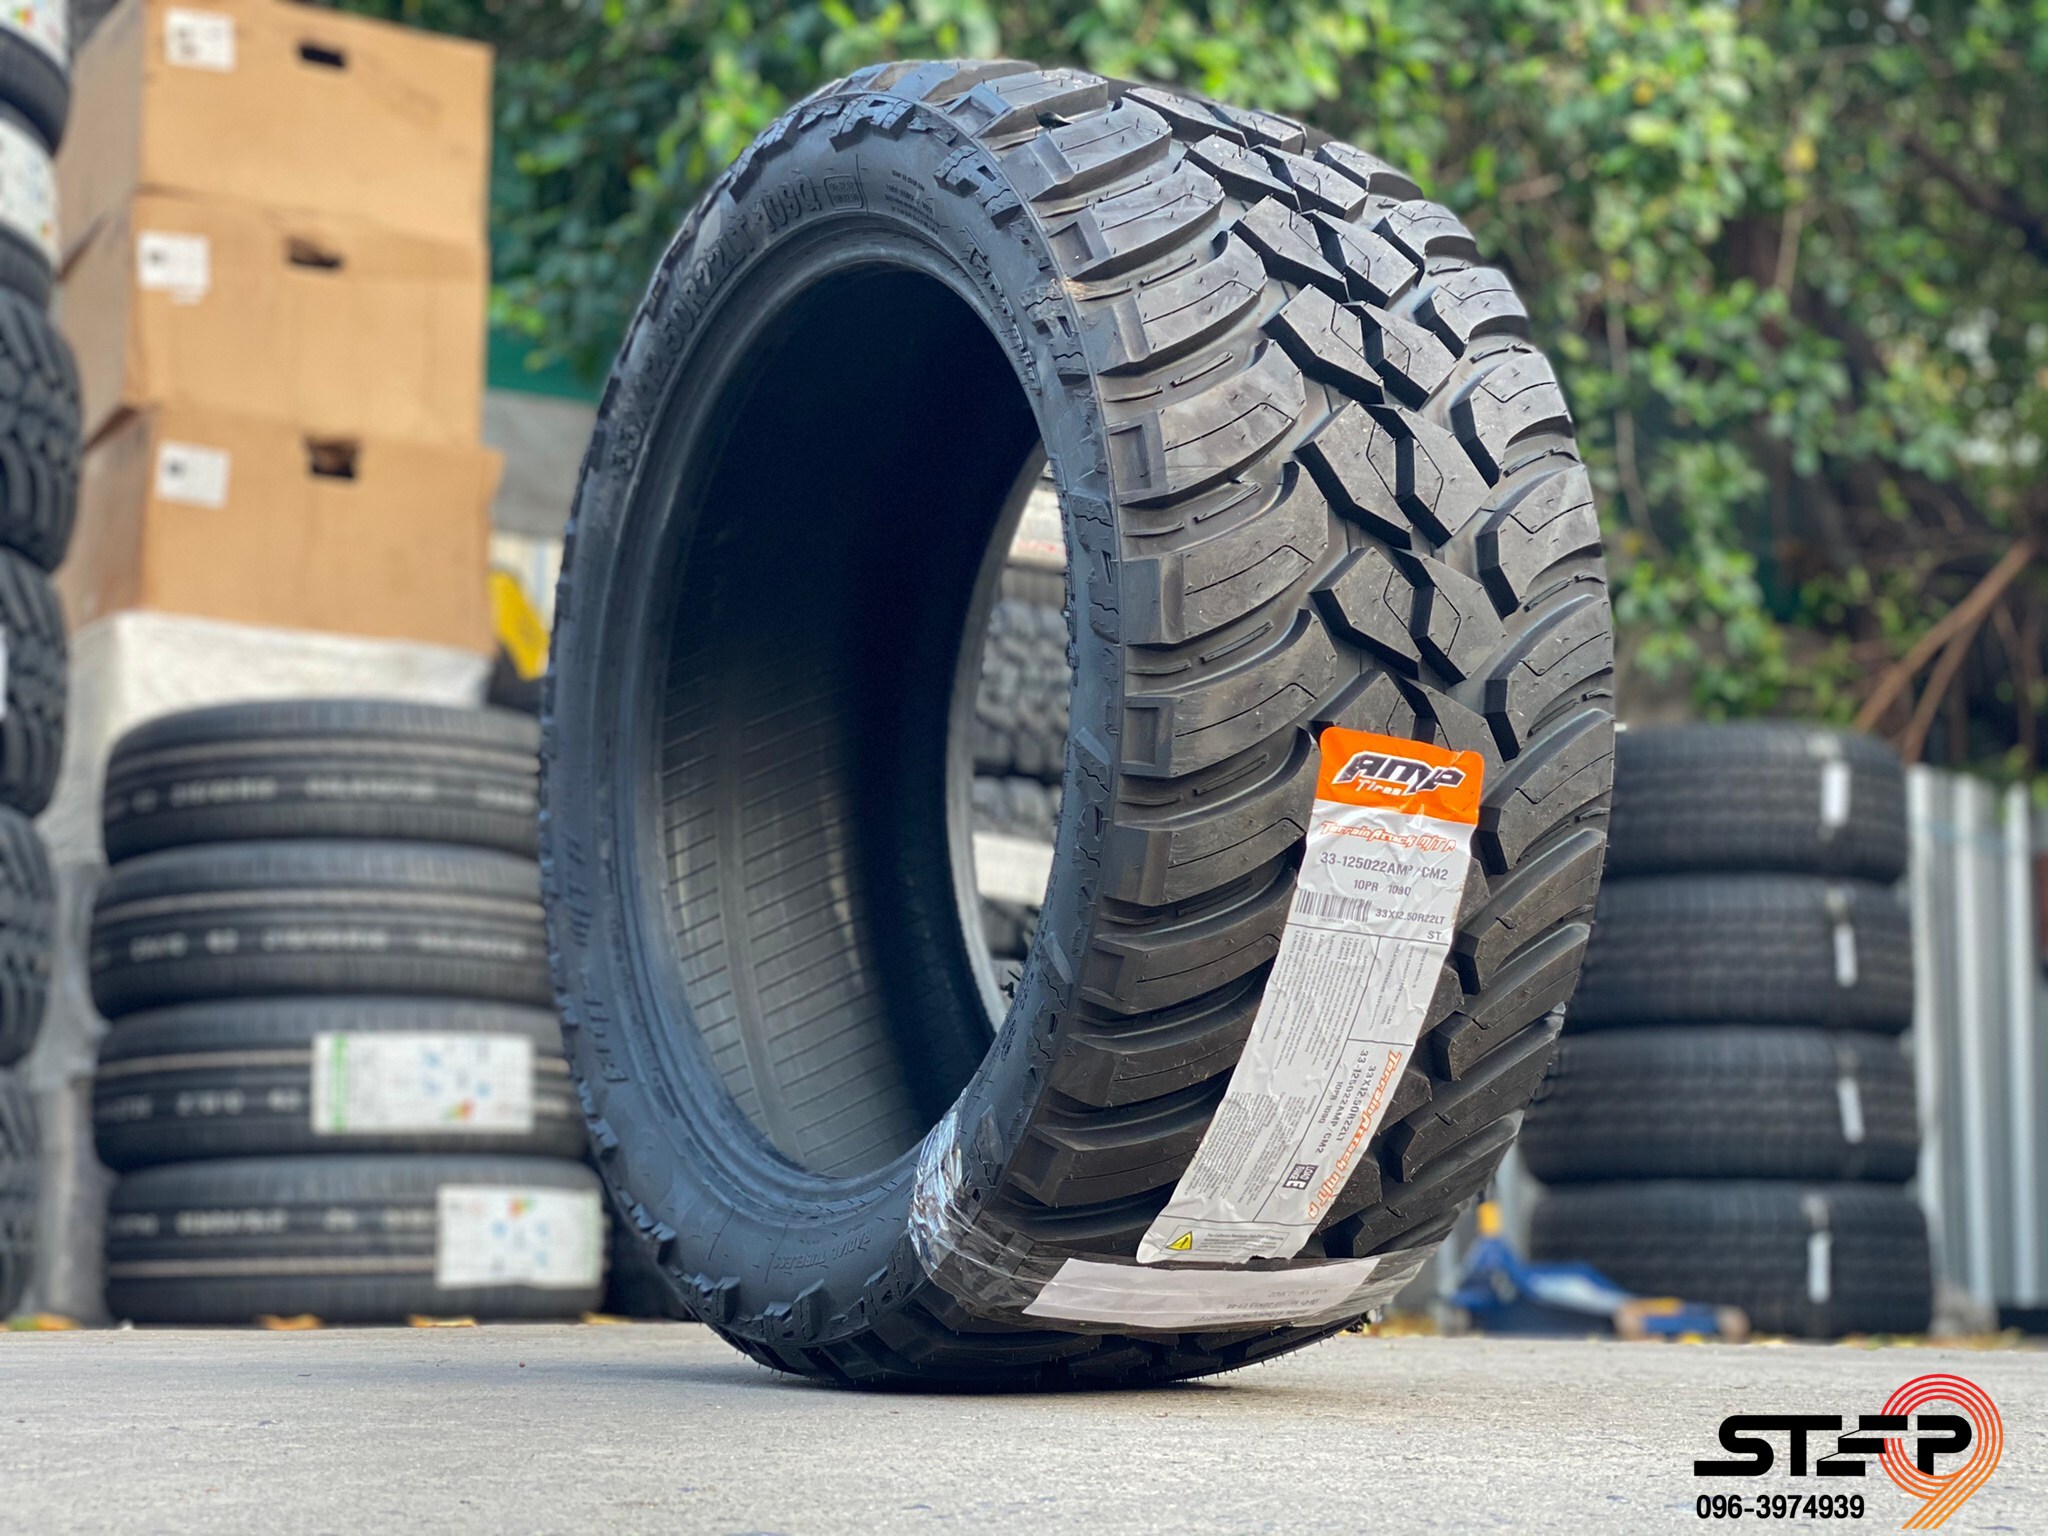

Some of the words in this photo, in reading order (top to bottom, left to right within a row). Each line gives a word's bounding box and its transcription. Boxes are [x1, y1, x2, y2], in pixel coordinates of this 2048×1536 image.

[1331, 750, 1466, 796] AMP
[1355, 778, 1402, 796] Tires
[1353, 879, 1379, 892] 10PR
[1375, 908, 1445, 925] 33X12.50R22LT
[1427, 930, 1443, 941] ST
[1329, 1081, 1344, 1101] 10PR
[1336, 1065, 1377, 1142] 33X12.50R22LT
